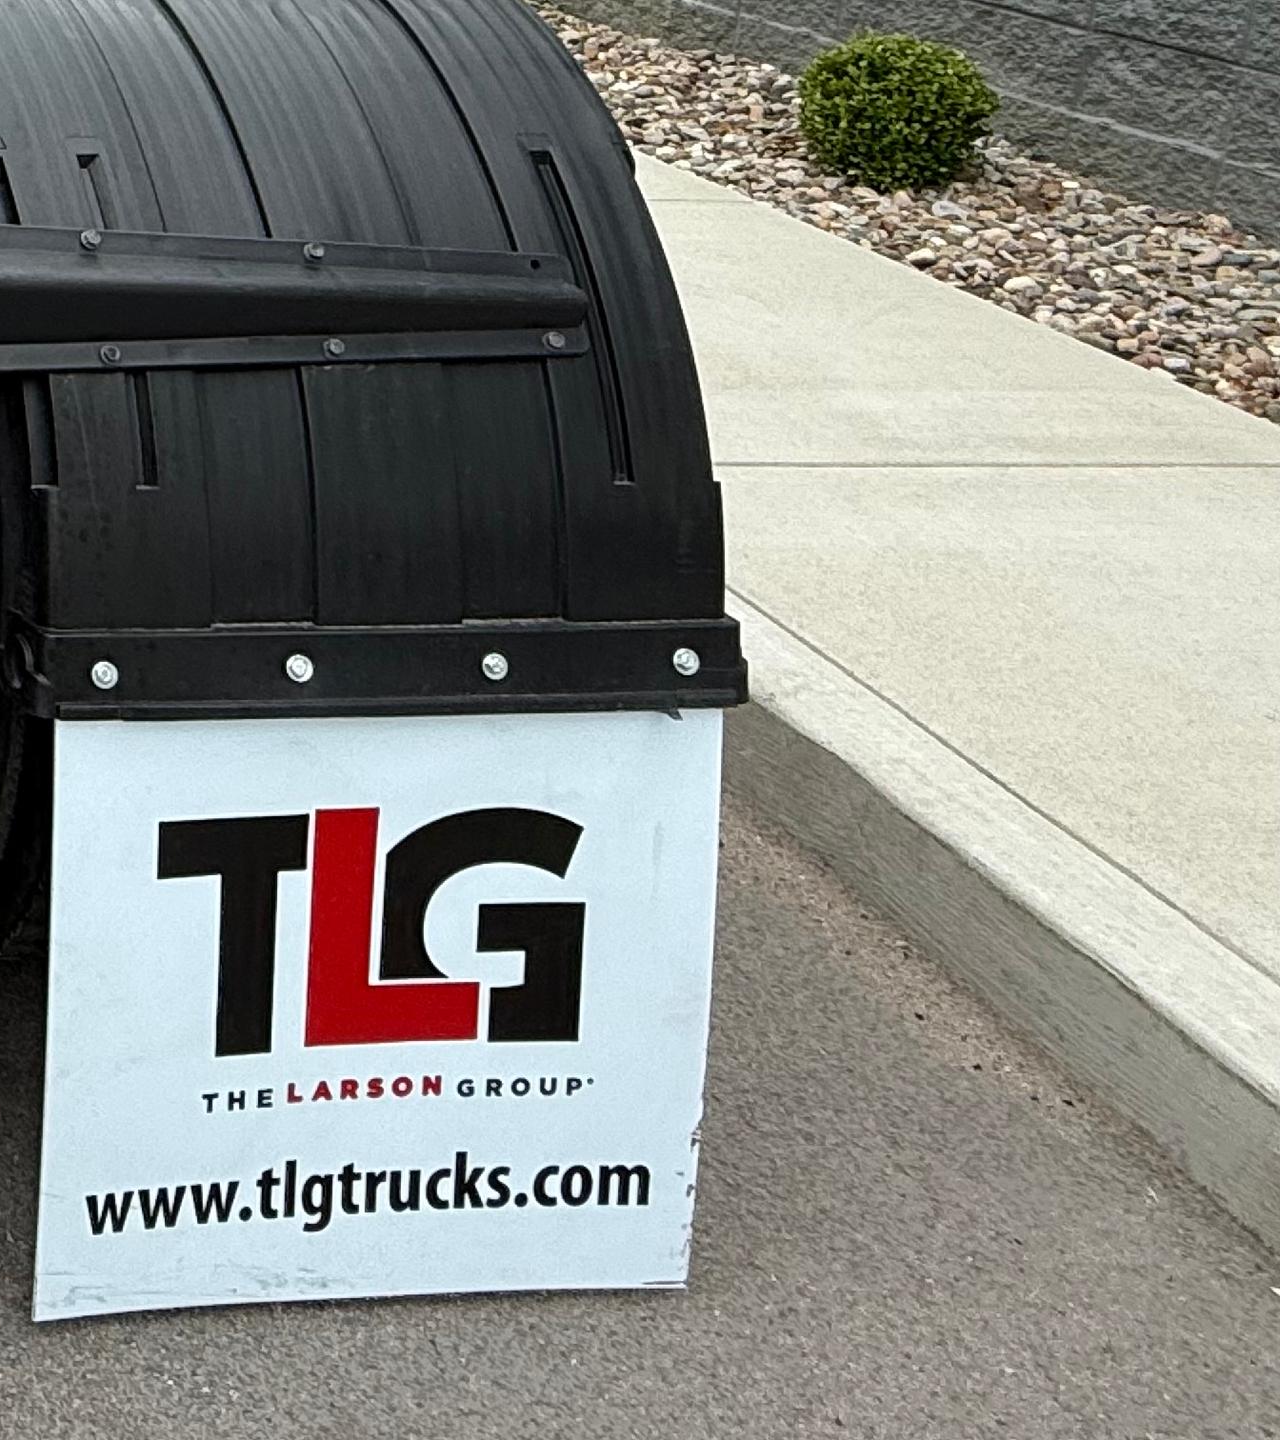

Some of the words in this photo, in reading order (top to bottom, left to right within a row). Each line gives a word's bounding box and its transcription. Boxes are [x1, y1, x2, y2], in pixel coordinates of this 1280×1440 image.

[156, 806, 587, 1058] TLG
[201, 1088, 274, 1114] THE
[286, 1075, 442, 1104] LARSON
[85, 1151, 651, 1236] www.tlgtrucks.com
